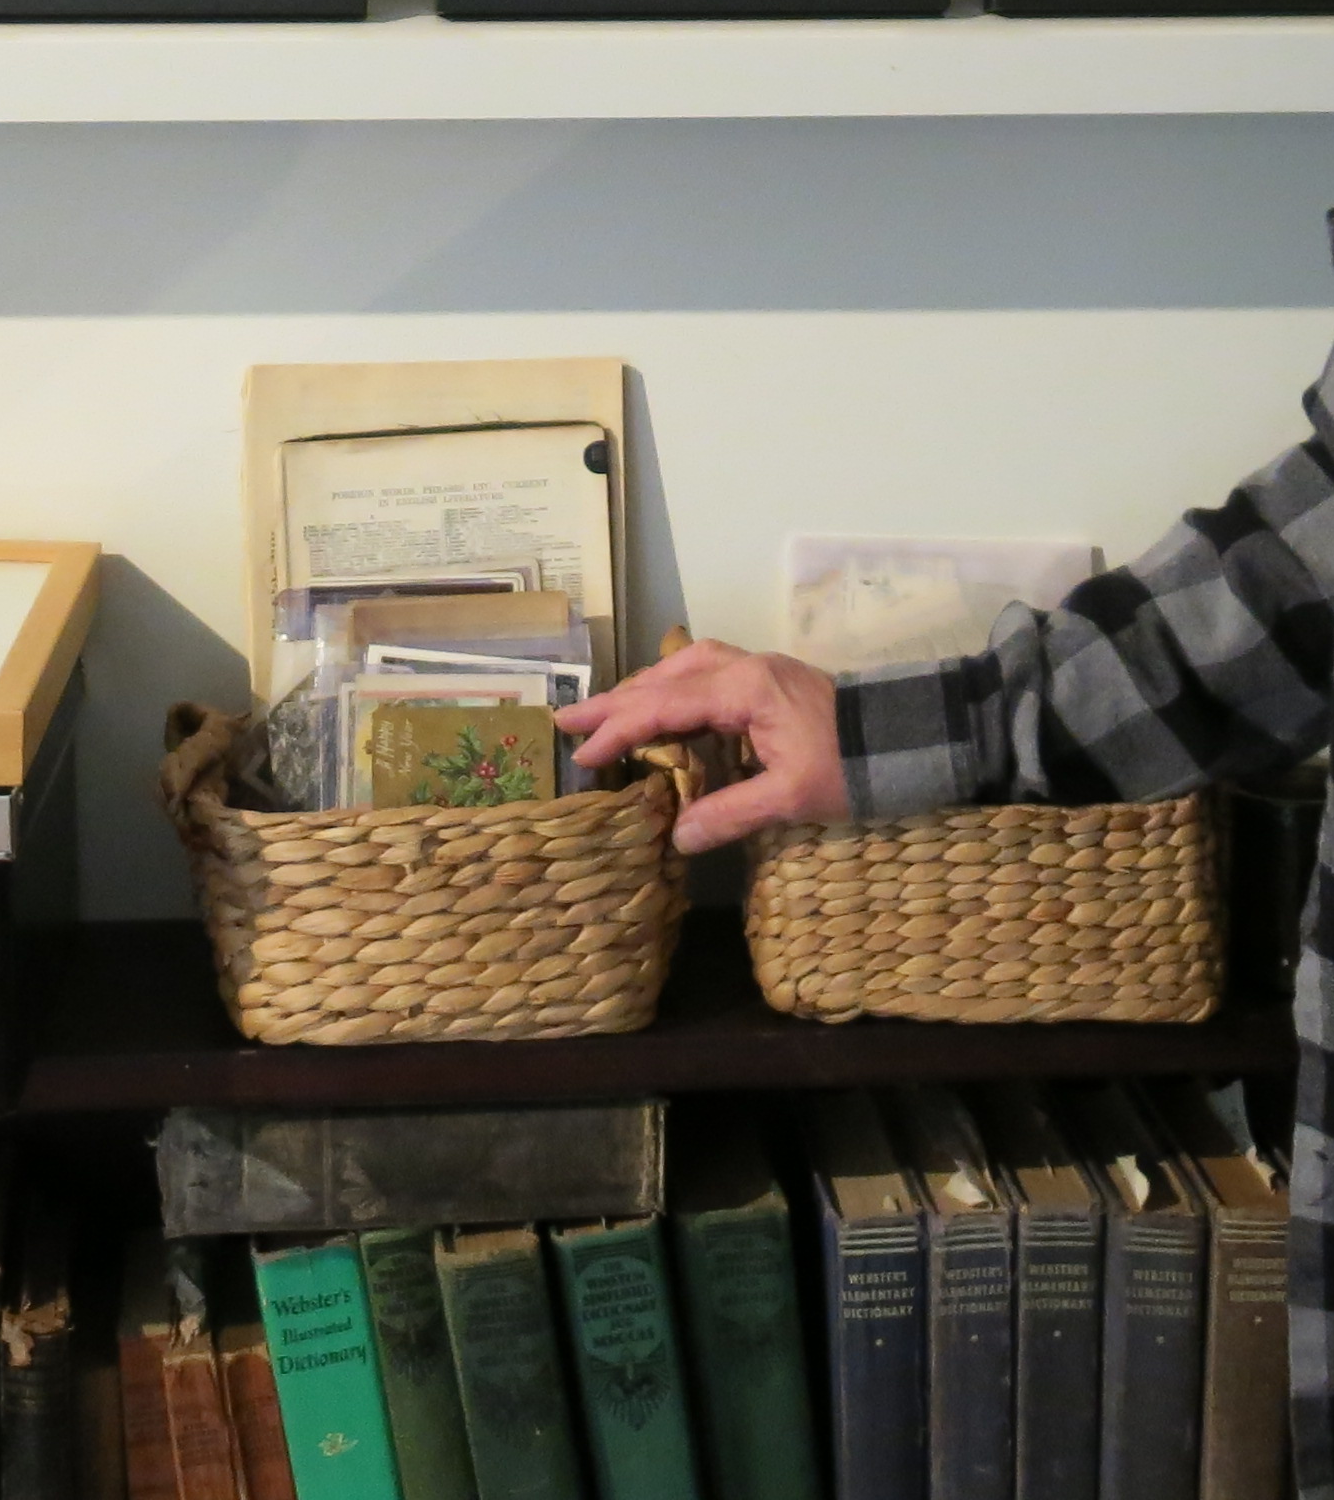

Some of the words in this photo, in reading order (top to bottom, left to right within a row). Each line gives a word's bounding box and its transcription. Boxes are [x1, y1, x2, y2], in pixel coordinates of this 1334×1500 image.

[272, 1288, 351, 1318] Webster's
[281, 1316, 353, 1346] Illustrated
[278, 1345, 367, 1375] Dictionary
